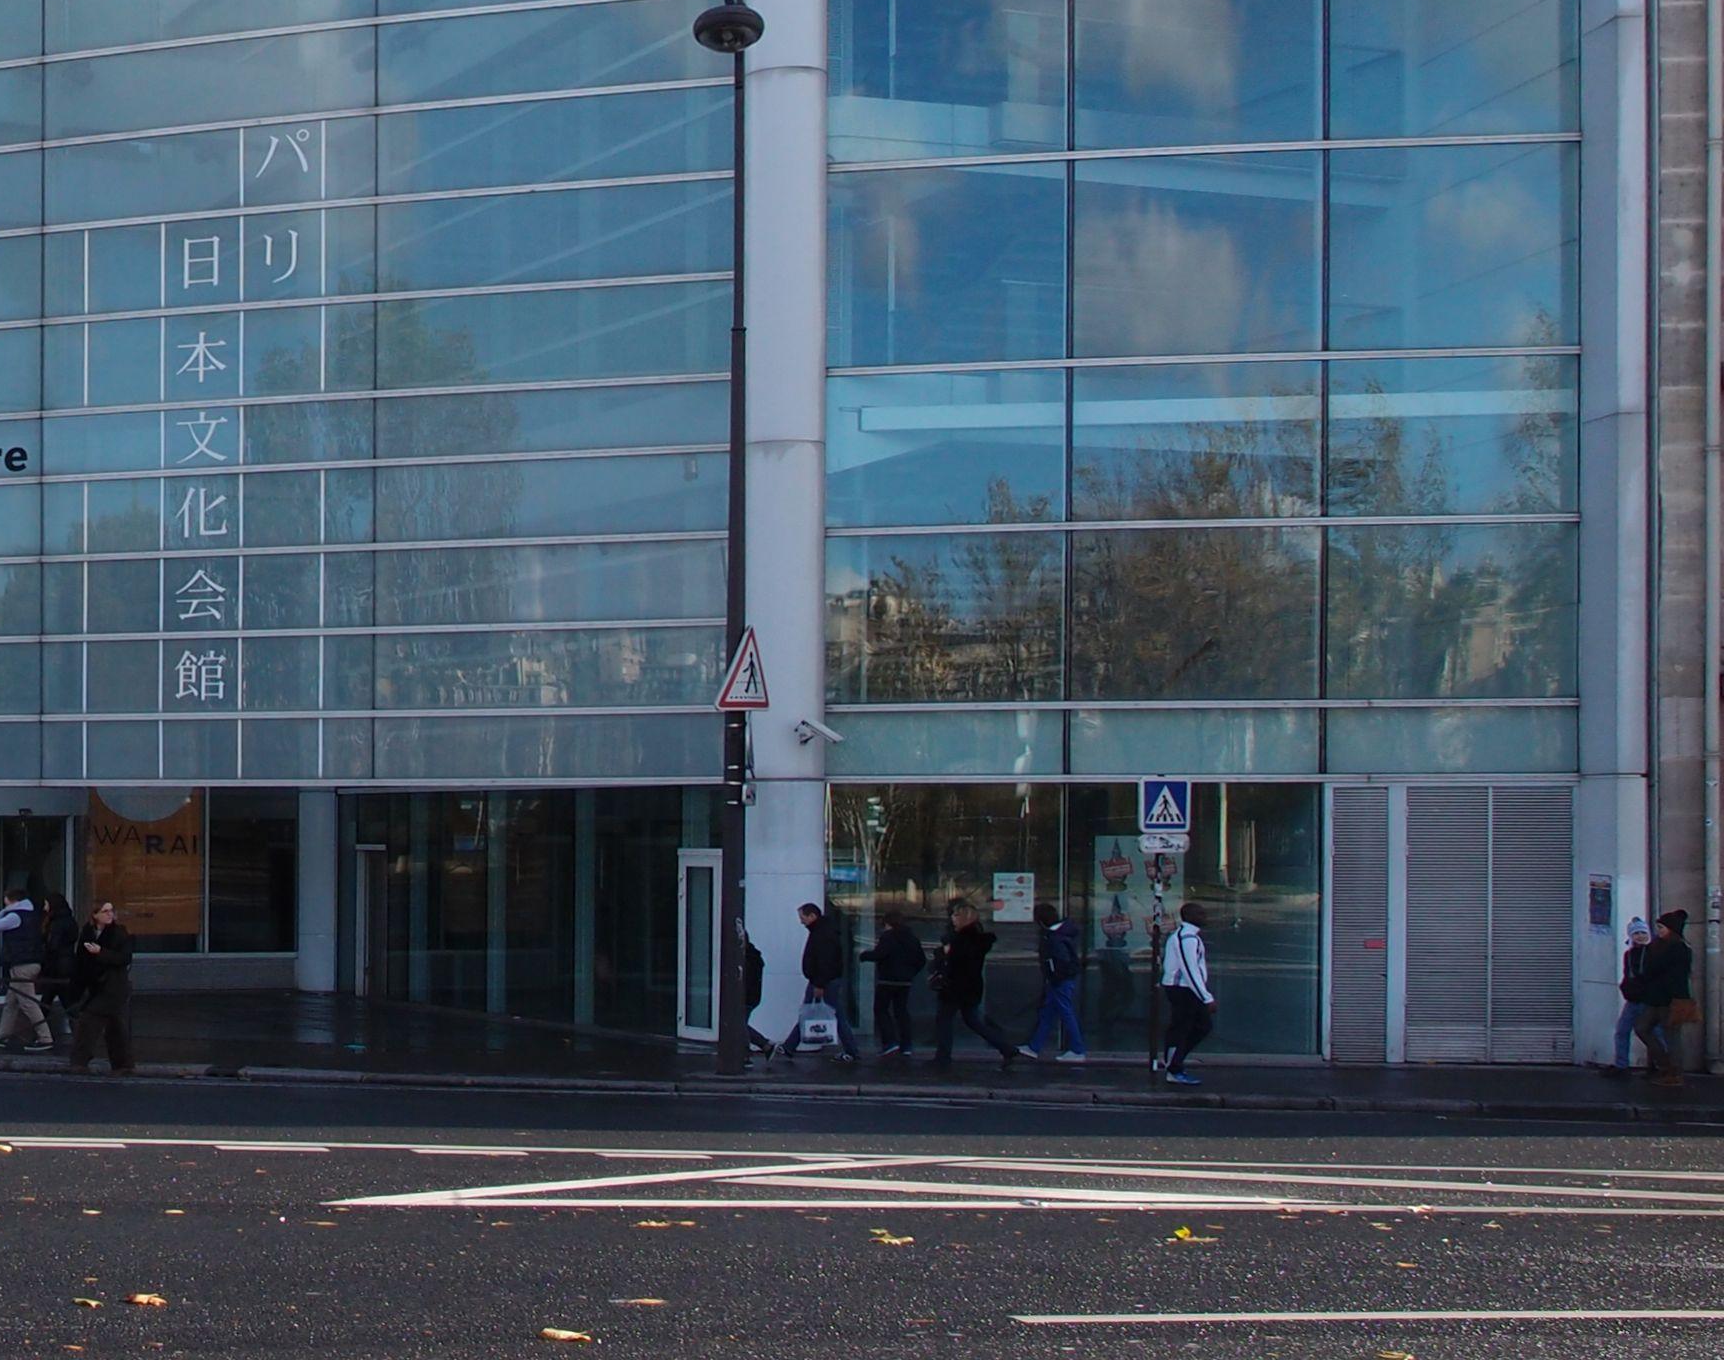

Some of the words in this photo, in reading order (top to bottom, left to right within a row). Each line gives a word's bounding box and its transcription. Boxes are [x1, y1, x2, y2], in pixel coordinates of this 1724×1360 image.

[254, 127, 311, 284] パリ
[175, 235, 228, 701] 日本文化会館
[92, 825, 198, 855] WARAI
